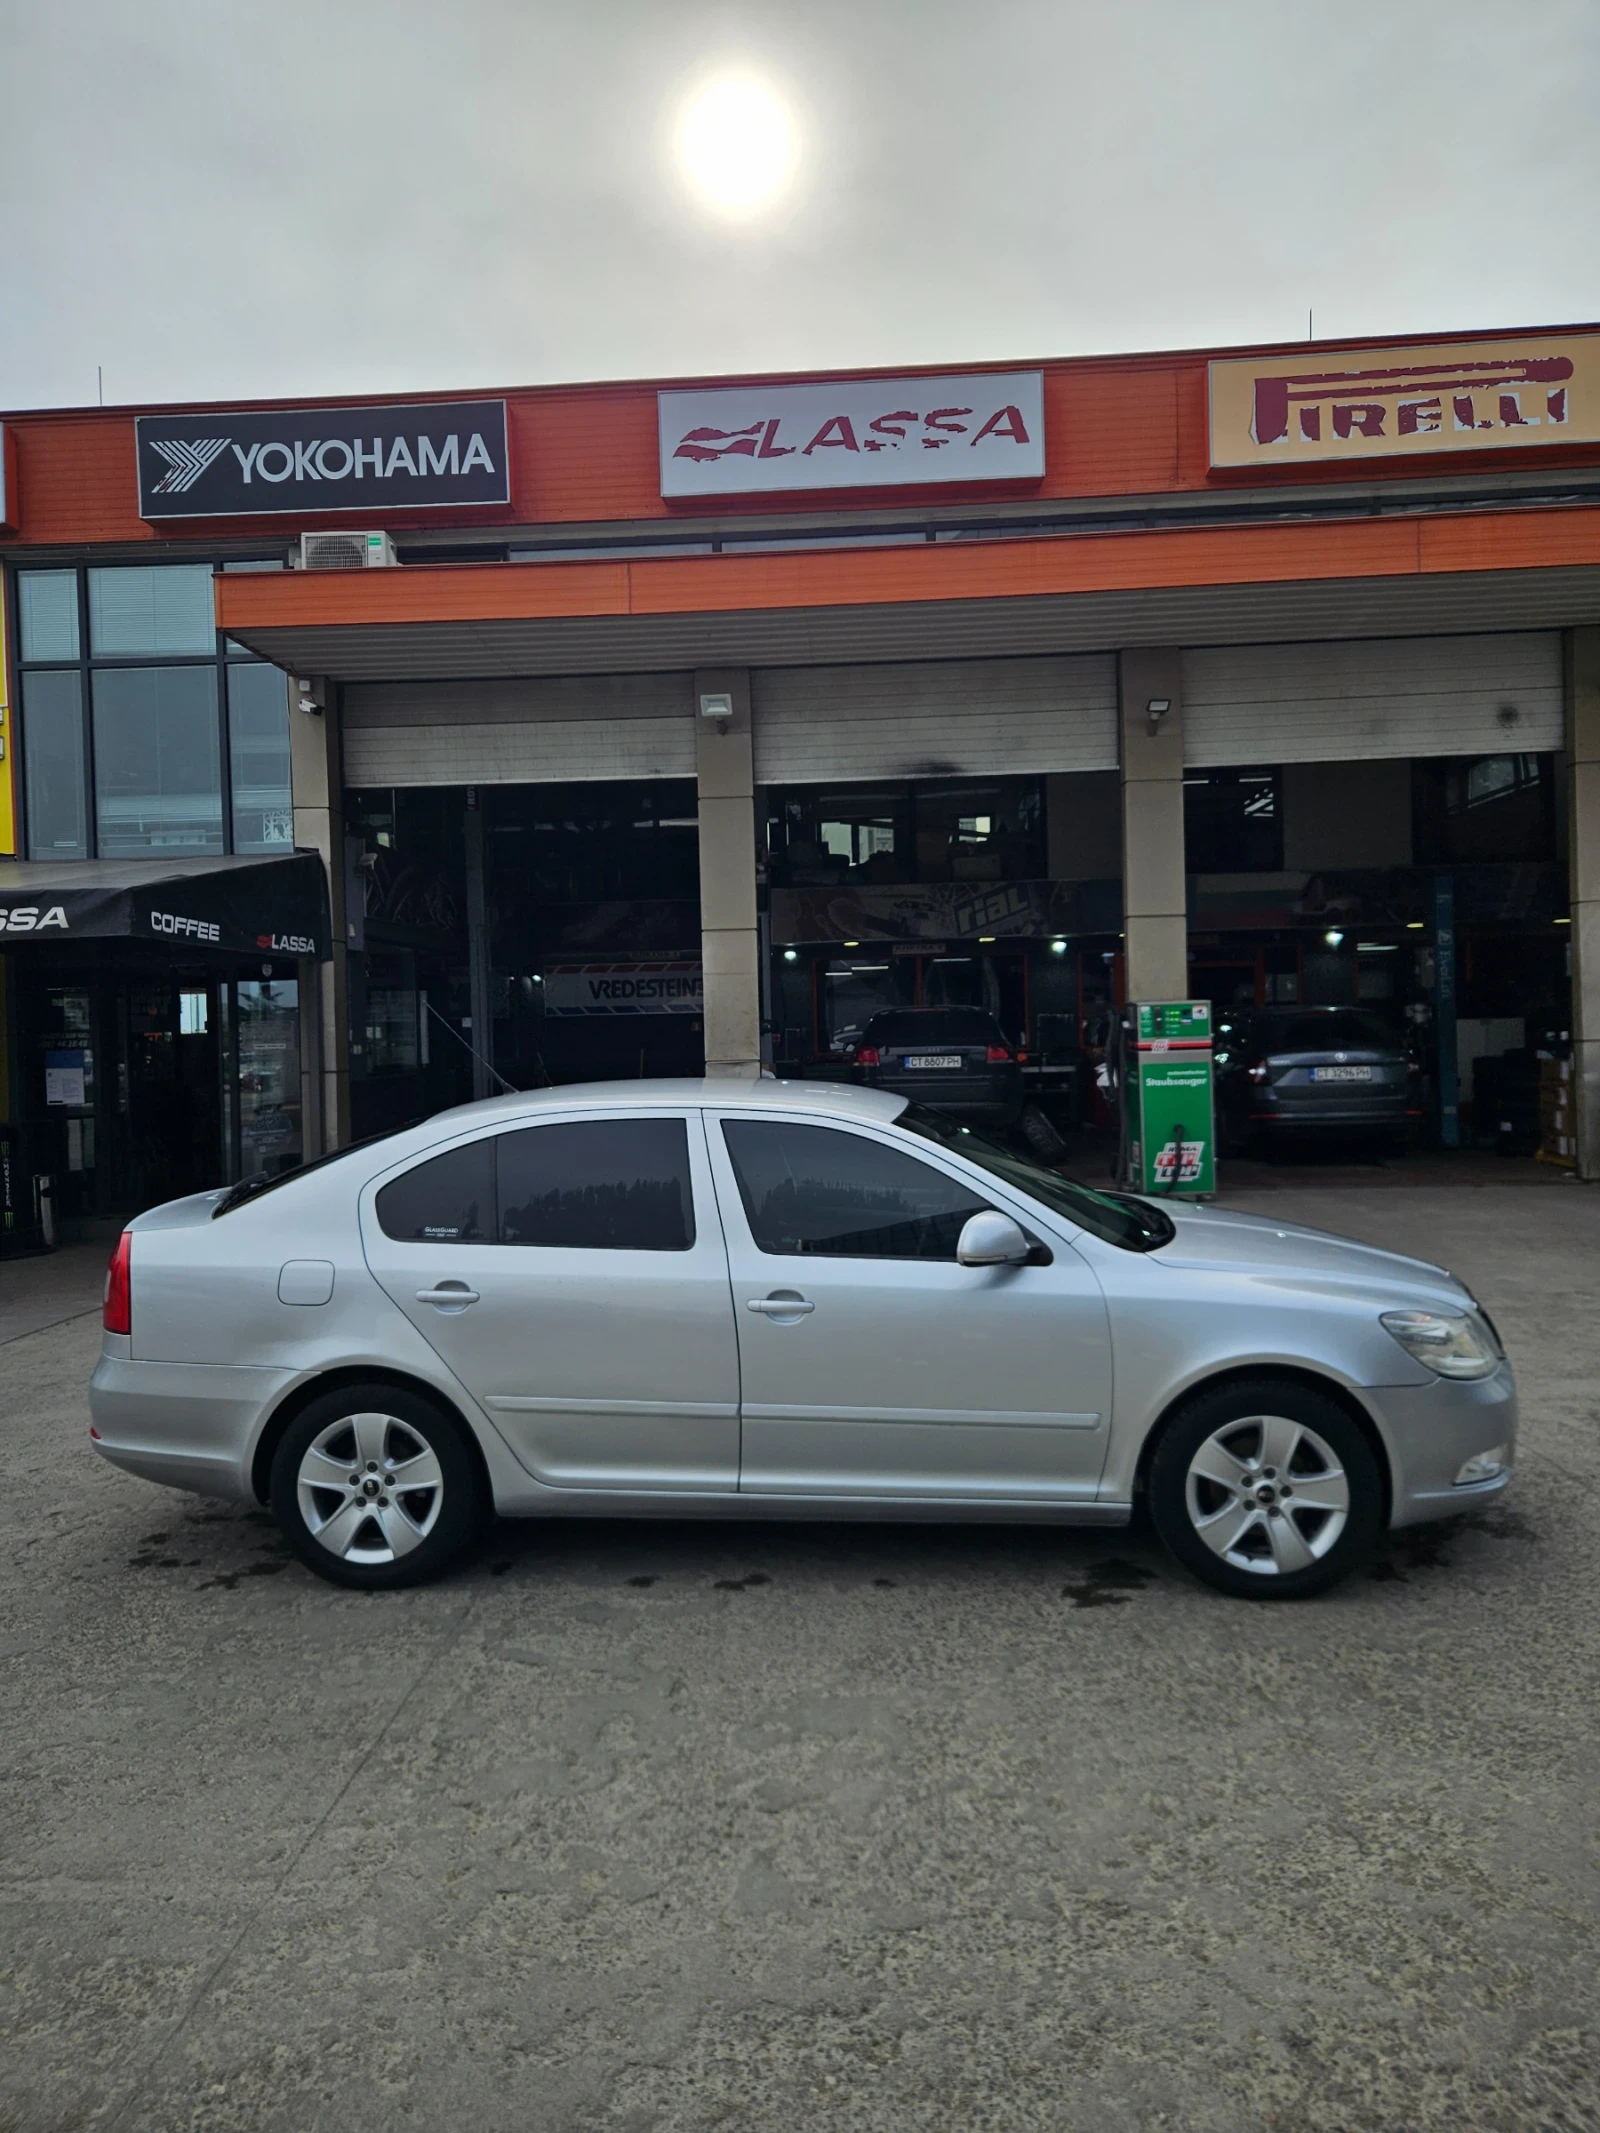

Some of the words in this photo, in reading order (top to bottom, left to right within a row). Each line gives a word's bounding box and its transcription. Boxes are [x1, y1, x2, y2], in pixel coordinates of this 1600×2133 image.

[1249, 356, 1574, 445] PIRELLI
[757, 405, 1031, 459] LASSA
[231, 433, 495, 484] YOKOHAMA
[0, 906, 70, 932] SA
[151, 911, 221, 942] COFFEE
[271, 933, 316, 954] LASSA
[911, 1057, 922, 1067] CT
[947, 1056, 959, 1066] PH
[1316, 1068, 1328, 1078] CT
